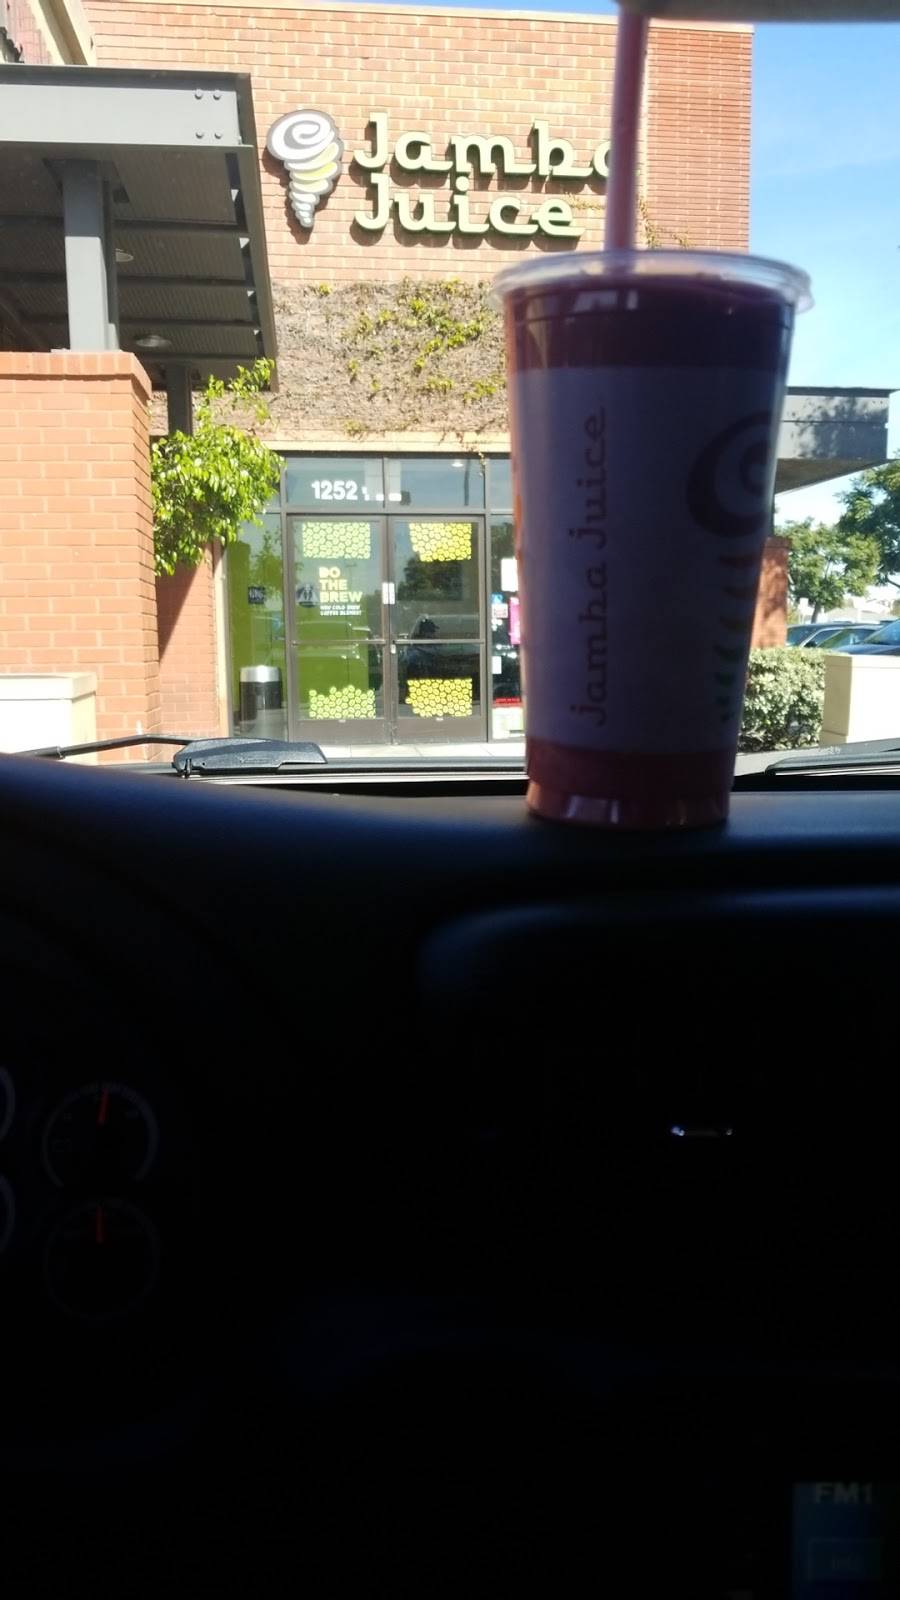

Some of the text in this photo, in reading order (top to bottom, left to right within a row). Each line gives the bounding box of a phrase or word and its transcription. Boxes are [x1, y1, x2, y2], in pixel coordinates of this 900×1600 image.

[354, 172, 586, 238] Juice
[311, 480, 358, 500] 1252
[569, 406, 609, 728] jamba juice
[319, 579, 348, 591] THE
[320, 591, 363, 603] BREW
[814, 1481, 874, 1504] FM1
